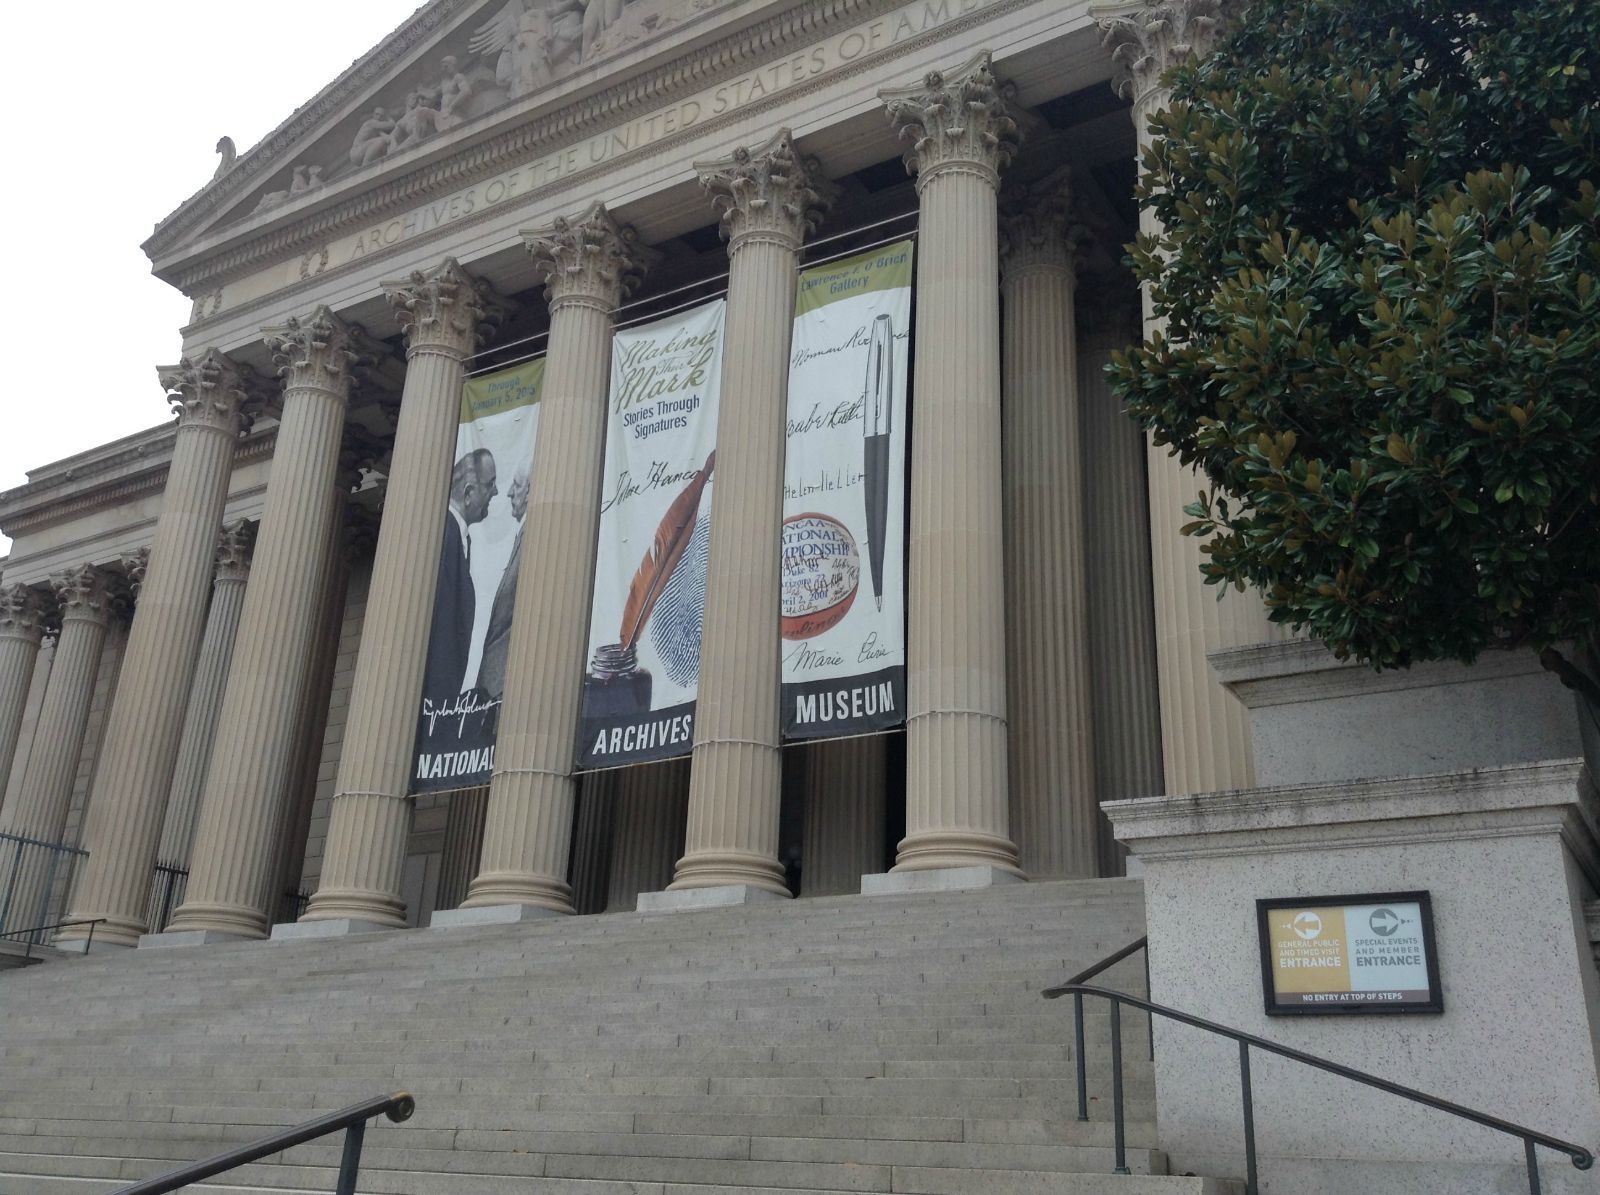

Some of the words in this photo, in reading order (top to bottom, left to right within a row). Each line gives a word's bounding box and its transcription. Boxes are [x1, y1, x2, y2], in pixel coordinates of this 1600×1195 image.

[349, 190, 476, 259] ARCHIVES
[485, 170, 518, 199] OF
[529, 149, 577, 189] THE
[589, 100, 702, 162] UNITED
[712, 48, 826, 115] STATES
[838, 22, 884, 62] OF
[831, 275, 870, 294] Gallery
[621, 327, 717, 372] Making
[487, 376, 520, 393] Through
[614, 347, 714, 415] Mark
[623, 407, 654, 427] Stories
[656, 394, 700, 415] Through
[634, 415, 687, 440] Signatures
[784, 519, 825, 533] NCAA
[783, 579, 811, 588] rizona
[809, 590, 828, 601] 2001
[782, 642, 844, 673] Marie
[796, 680, 895, 724] MUSEUM
[592, 714, 692, 755] ARCHIVES
[416, 744, 495, 779] NATIONAL
[1278, 940, 1311, 948] GENERAL
[1355, 938, 1387, 946] SPECIAL
[1388, 937, 1418, 945] EVENTS
[1379, 946, 1420, 954] MEMBER
[1279, 949, 1295, 957] AND
[1356, 955, 1421, 967] ENTRANCE
[1280, 956, 1342, 968] ENTRANCE
[1378, 992, 1403, 1000] STEPS
